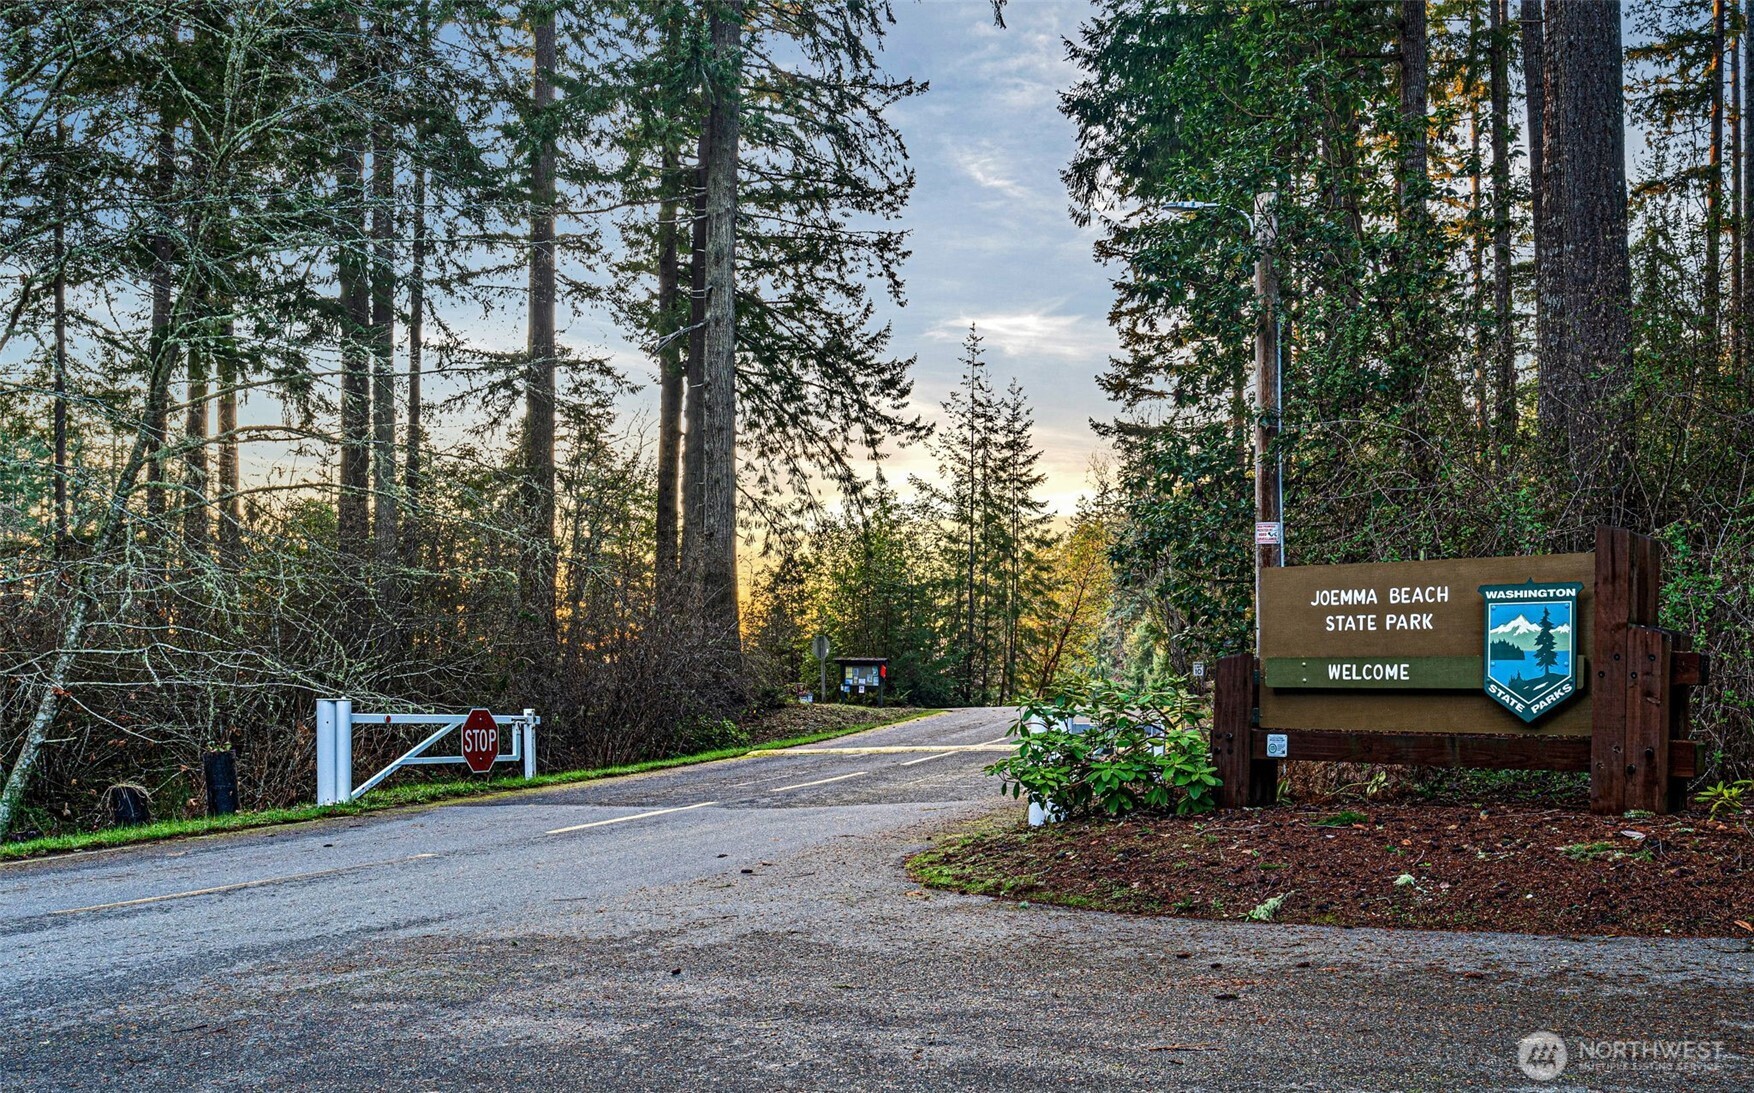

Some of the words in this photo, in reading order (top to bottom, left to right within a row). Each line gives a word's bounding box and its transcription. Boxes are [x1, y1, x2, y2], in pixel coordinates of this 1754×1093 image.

[1310, 588, 1378, 606] JOEMMA
[1389, 585, 1449, 604] BEACH
[1485, 588, 1577, 600] WASHINGTON
[1325, 614, 1377, 632] STATE
[1385, 613, 1434, 631] PARK
[1328, 663, 1410, 681] WELCOME
[1488, 683, 1525, 713] STATE
[1531, 682, 1573, 714] PARKS
[464, 729, 497, 753] STOP
